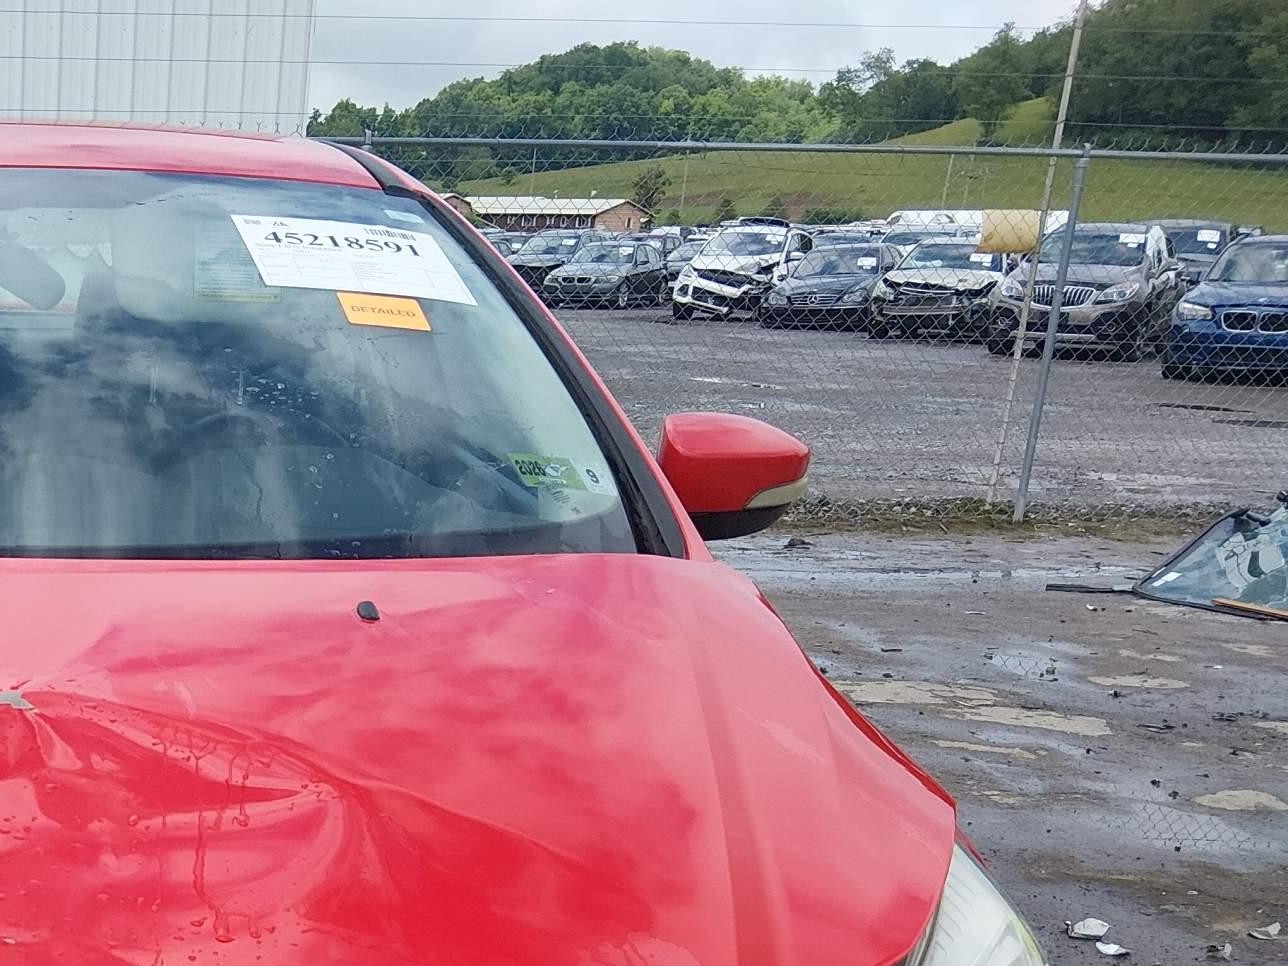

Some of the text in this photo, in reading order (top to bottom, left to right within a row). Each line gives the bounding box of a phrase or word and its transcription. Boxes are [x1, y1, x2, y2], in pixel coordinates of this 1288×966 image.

[264, 230, 422, 257] 45218591
[350, 304, 416, 319] DETAILED
[514, 459, 547, 477] 2026
